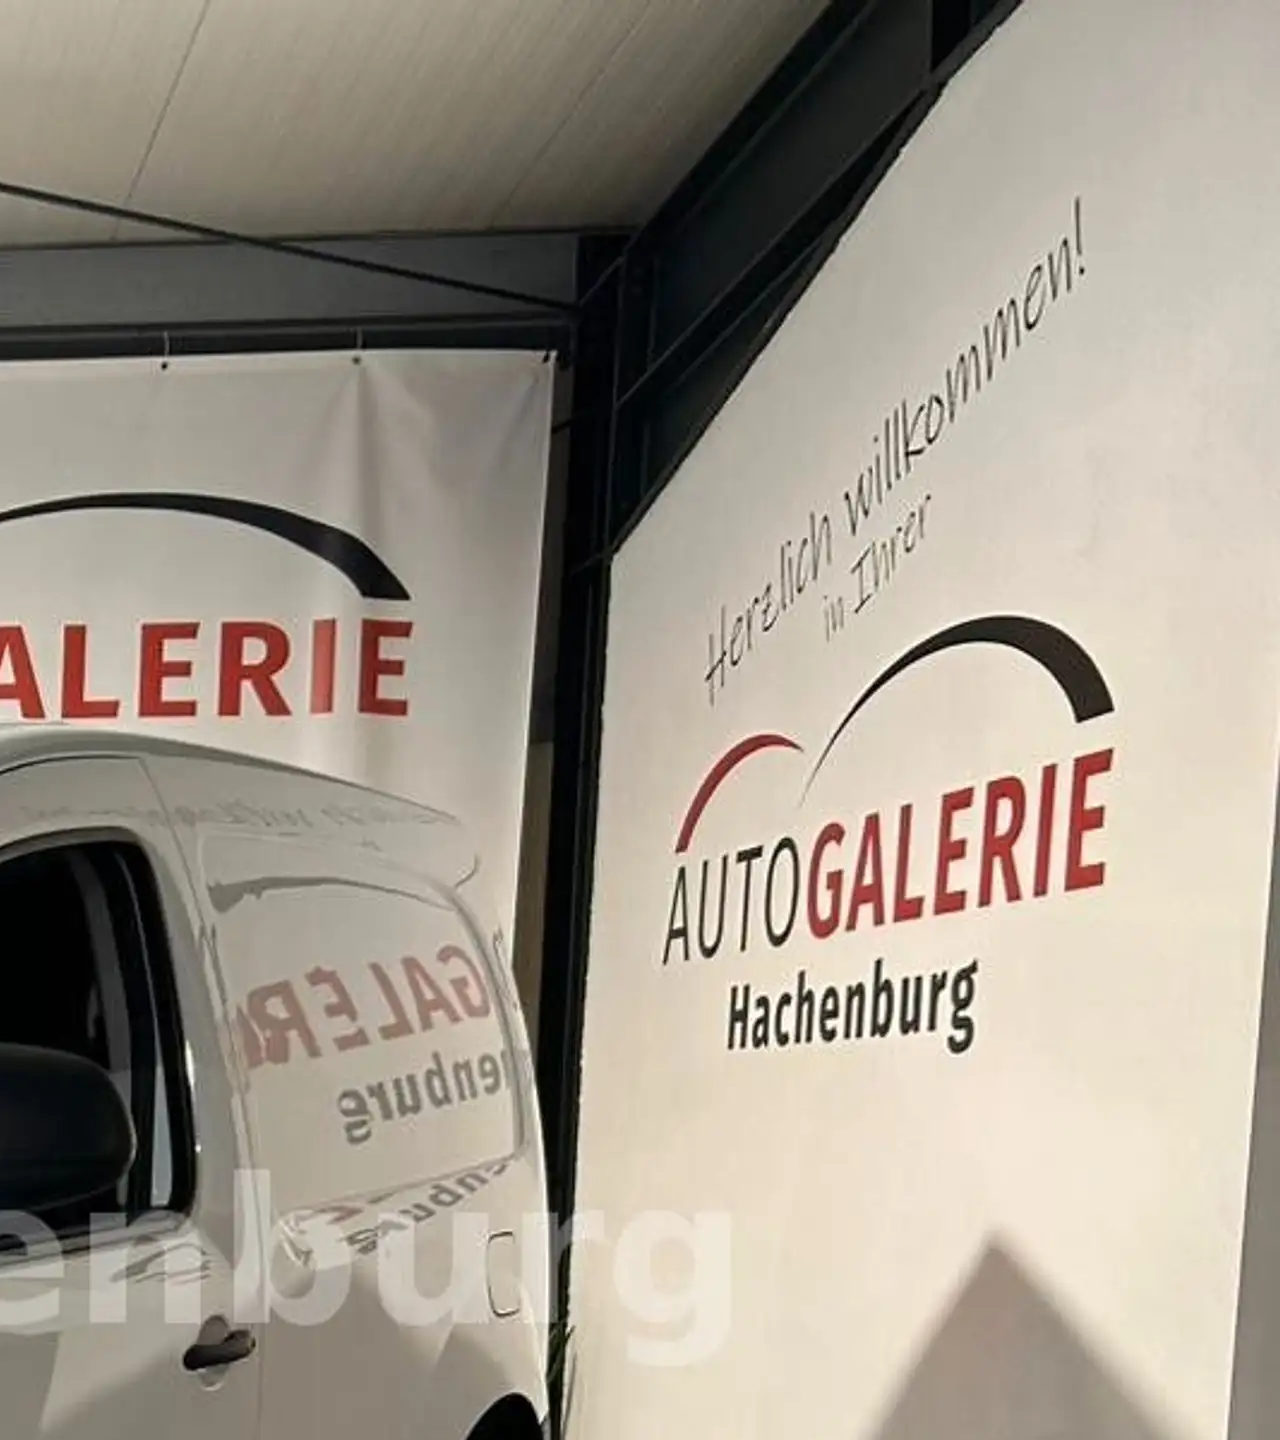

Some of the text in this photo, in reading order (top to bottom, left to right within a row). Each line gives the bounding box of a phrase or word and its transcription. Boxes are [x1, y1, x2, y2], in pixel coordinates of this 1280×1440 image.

[703, 196, 1087, 704] Herzlich willkommen!
[822, 493, 933, 643] in Ihrer
[663, 747, 1115, 965] AUTOGALERIE
[726, 957, 979, 1055] Hachenburg
